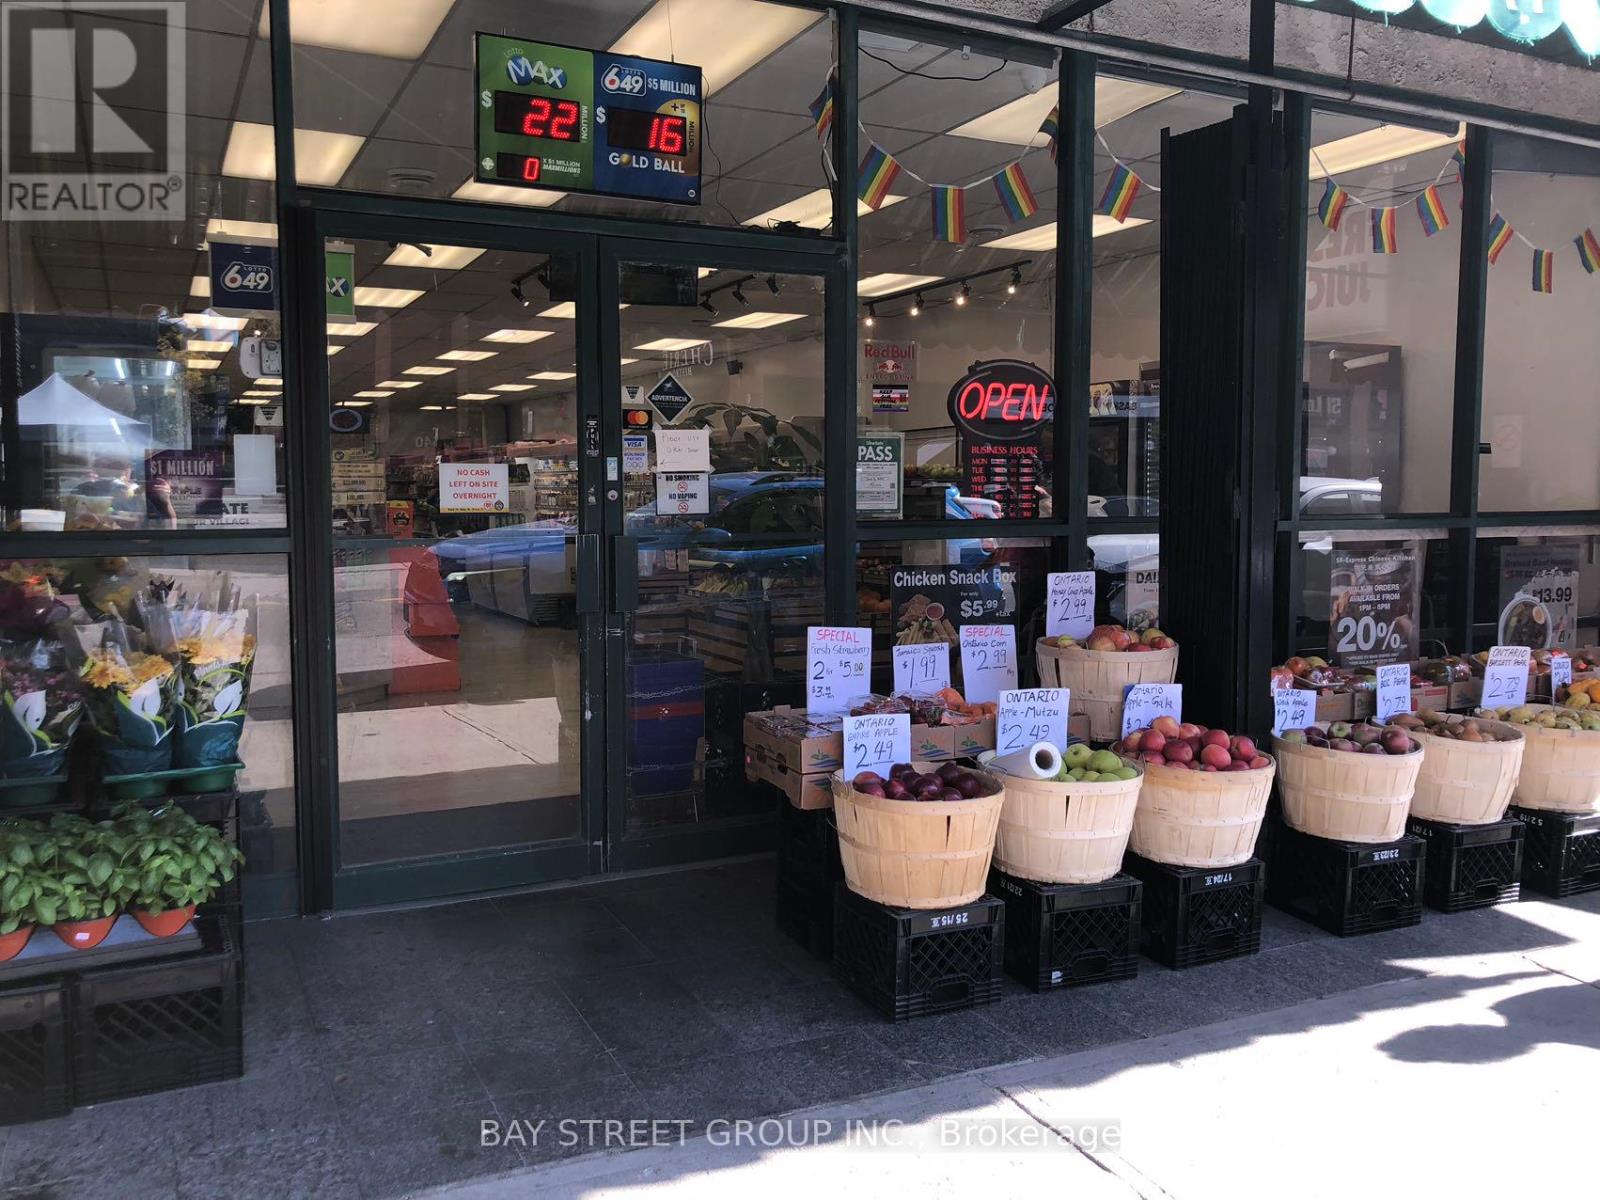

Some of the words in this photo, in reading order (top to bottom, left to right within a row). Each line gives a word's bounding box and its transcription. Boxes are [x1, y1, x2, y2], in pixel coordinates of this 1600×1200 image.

[507, 56, 563, 89] MAX
[647, 77, 658, 90] $5
[660, 78, 696, 96] MILLION
[481, 89, 492, 108] $
[523, 97, 578, 140] 22
[596, 106, 606, 124] $
[648, 117, 682, 153] 16
[524, 157, 540, 180] 0
[654, 157, 685, 174] BALL
[959, 382, 1049, 421] OPEN
[857, 445, 893, 461] PASS
[971, 446, 1007, 454] BUSINESS
[1010, 446, 1038, 455] HOURS
[166, 460, 214, 476] MILLION
[674, 474, 700, 482] SMOKING
[677, 492, 698, 500] VAPING
[894, 570, 946, 588] Chicken
[949, 569, 989, 585] Snack
[992, 568, 1017, 583] Box
[1054, 574, 1090, 586] ONTARIO
[1136, 572, 1159, 584] DAI
[960, 599, 998, 619] $5.99
[816, 628, 860, 643] SPECIAL
[965, 626, 1010, 637] SPECIAL
[1336, 615, 1400, 653] 20%
[811, 643, 831, 655] Fresh
[1492, 647, 1528, 658] ONTARIO
[813, 660, 825, 680] 2
[1006, 690, 1060, 704] ONTARIO
[855, 717, 896, 730] ONTARIO
[874, 727, 898, 738] APPLE
